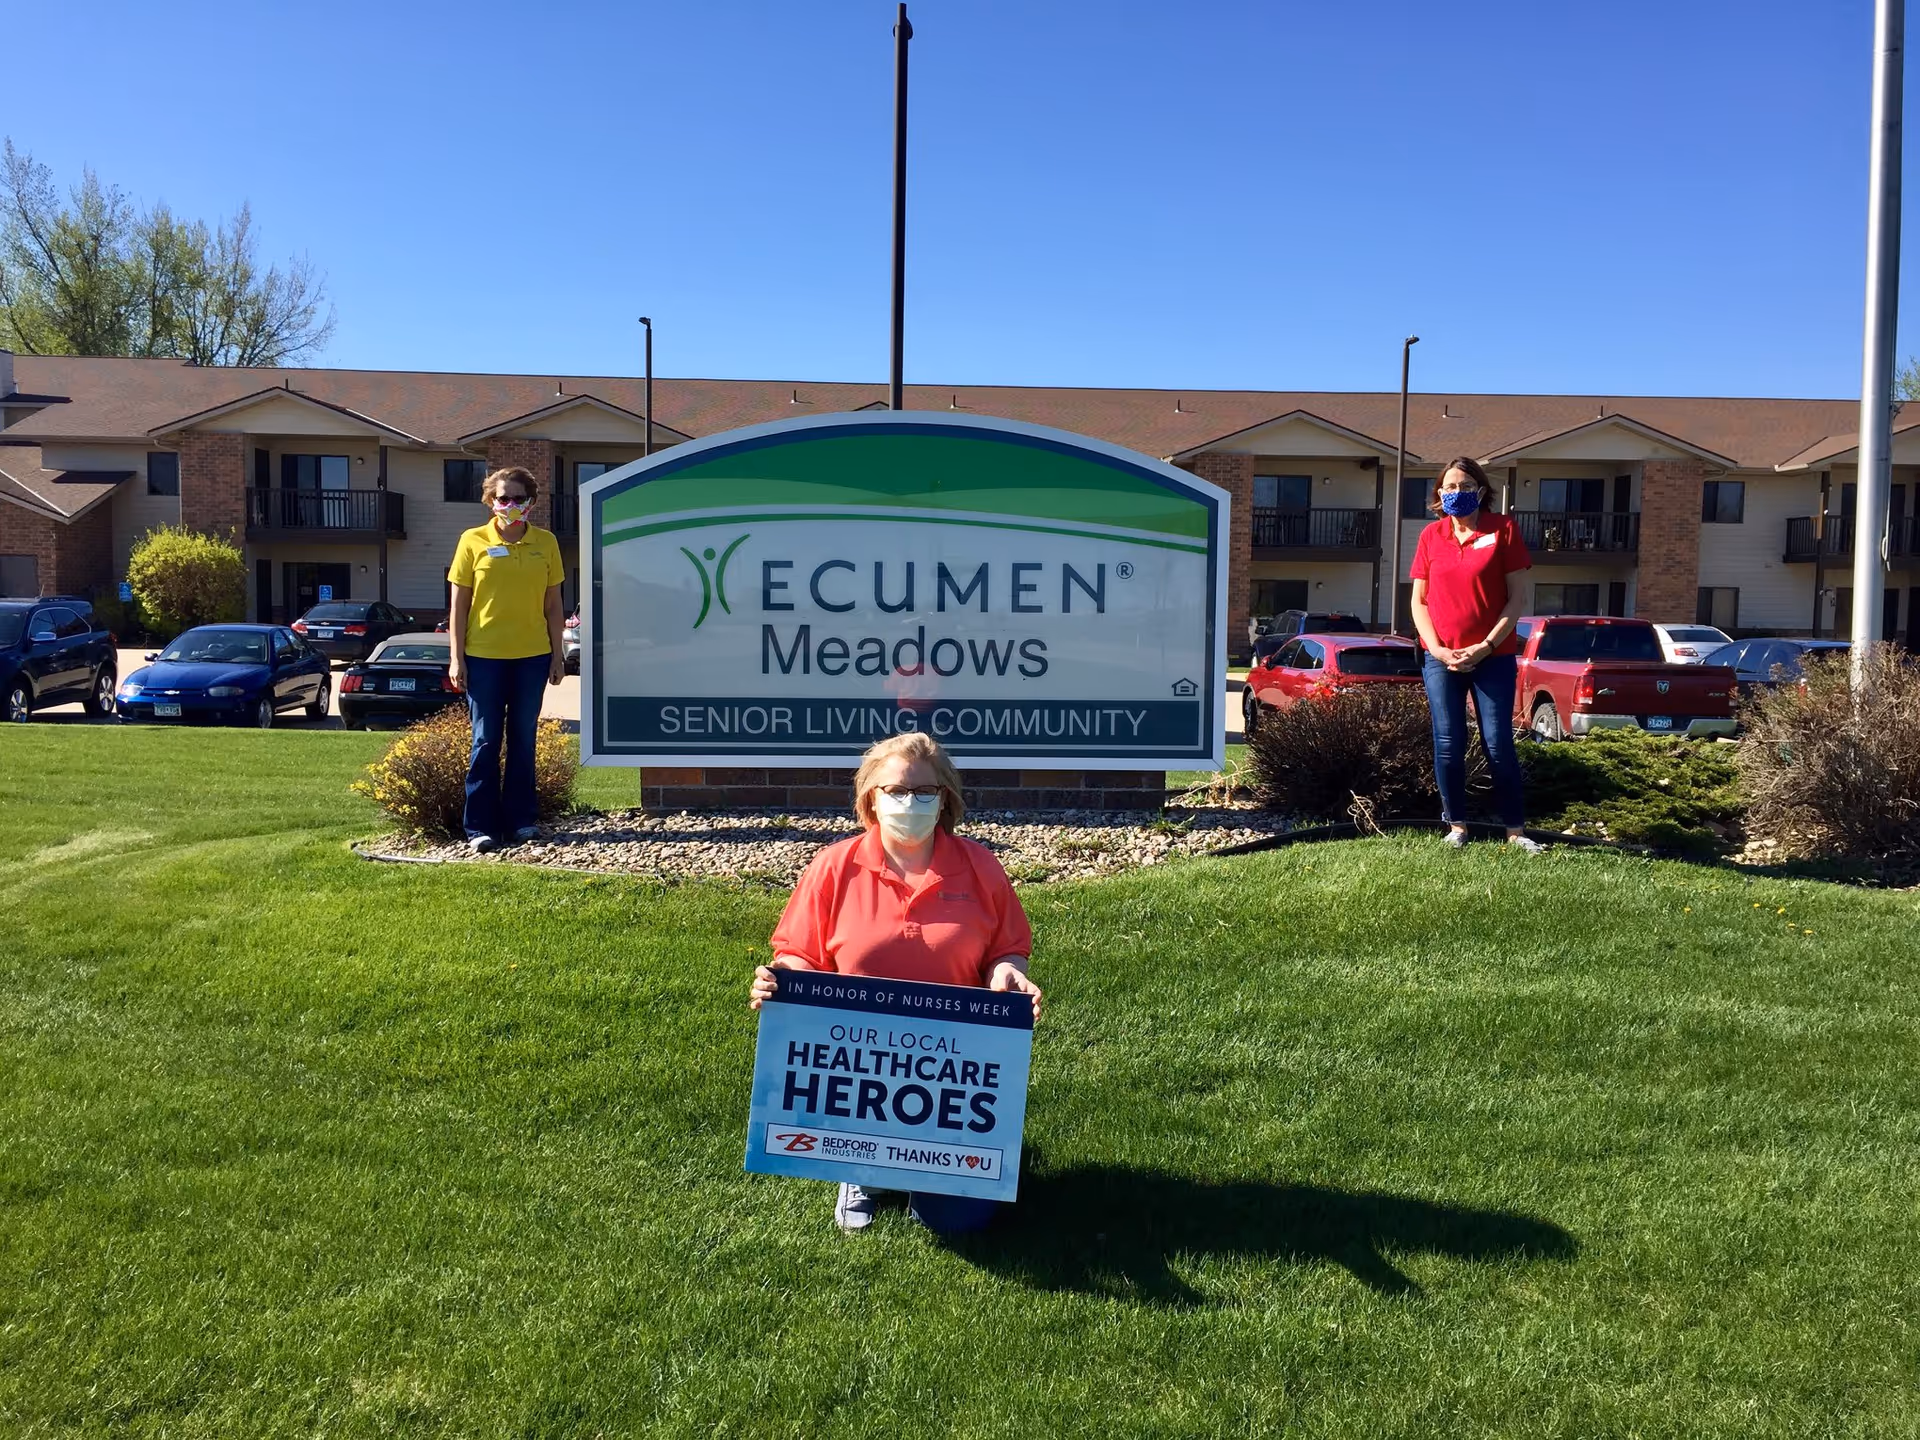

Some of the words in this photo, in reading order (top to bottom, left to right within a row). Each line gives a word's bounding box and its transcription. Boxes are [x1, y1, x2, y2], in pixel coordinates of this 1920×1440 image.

[762, 624, 1049, 679] Meadows
[659, 705, 793, 735] SENIOR
[805, 707, 919, 736] LIVING
[931, 708, 1147, 737] COMMUNITY
[788, 981, 804, 994] IN
[811, 984, 868, 1002] HONOR
[876, 991, 895, 1004] OF
[902, 994, 962, 1011] NURSES
[969, 1001, 1011, 1017] WEEK
[829, 1024, 878, 1045] OUR
[888, 1031, 961, 1054] LOCAL
[787, 1040, 1001, 1088] HEALTHCARE
[782, 1070, 998, 1134] HEROES
[821, 1147, 877, 1160] INDUSTRIES
[822, 1136, 879, 1153] BEDFORD
[886, 1145, 951, 1167] THANKS
